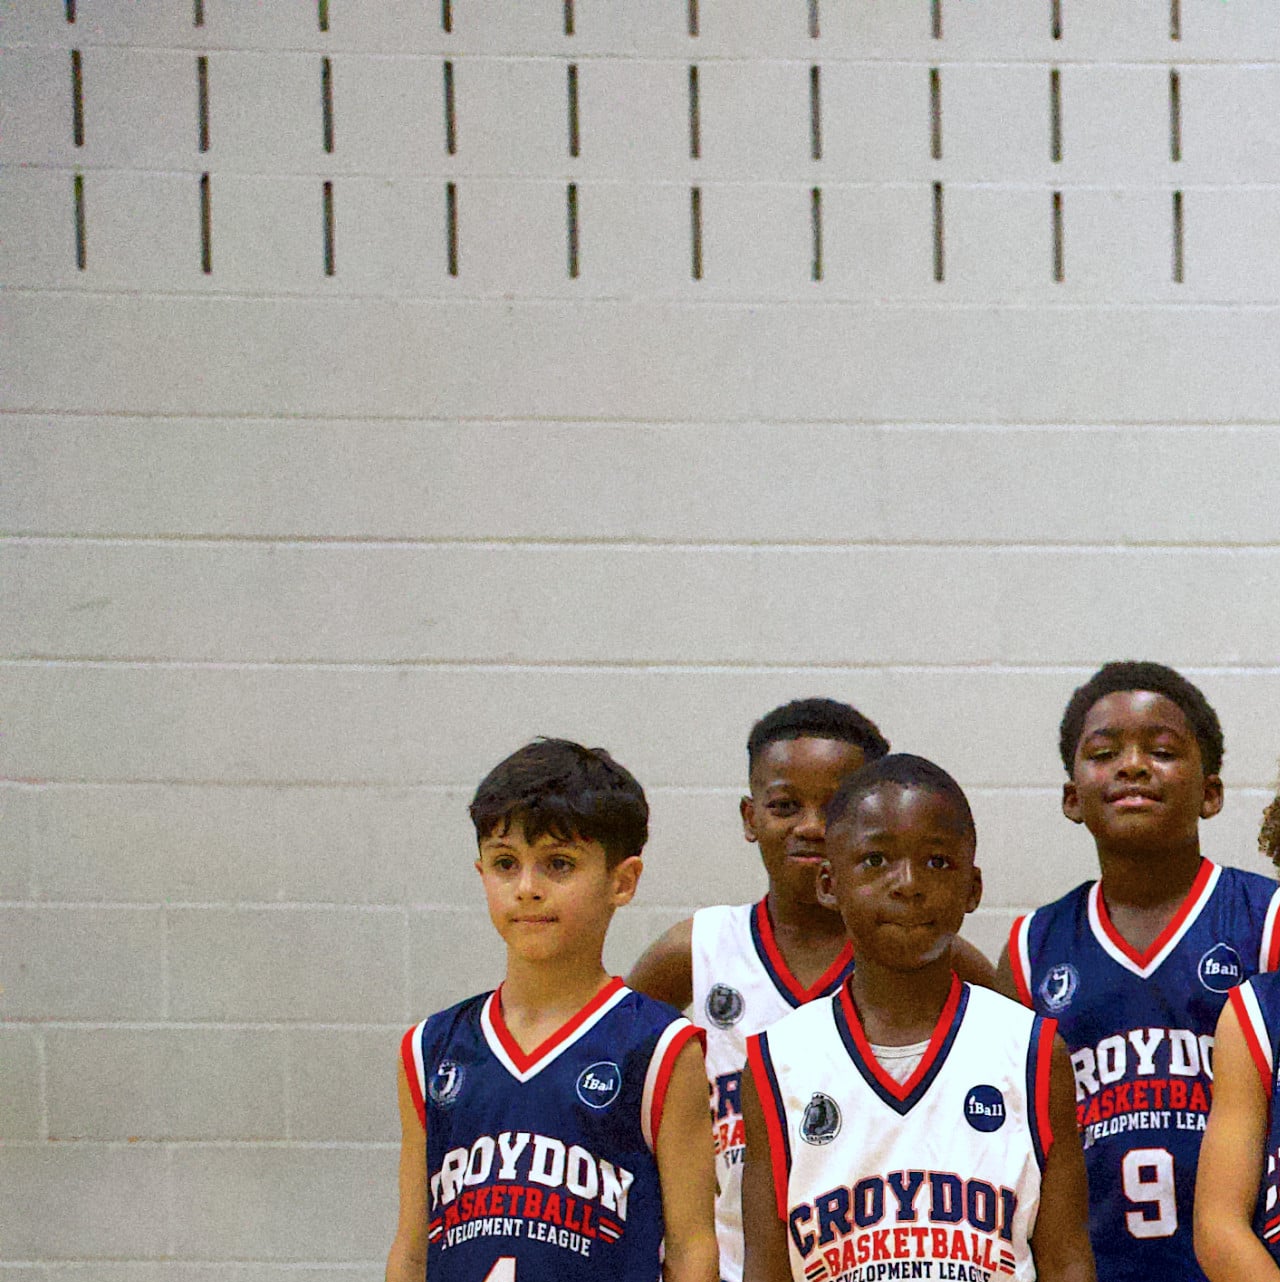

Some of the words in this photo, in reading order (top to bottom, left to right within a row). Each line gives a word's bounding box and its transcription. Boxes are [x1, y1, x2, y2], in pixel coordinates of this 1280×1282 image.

[967, 1094, 1003, 1118] iBall
[430, 1131, 635, 1222] ROYDON
[1121, 1147, 1179, 1240] 9
[528, 1220, 592, 1257] LEAGUE
[824, 1227, 998, 1277] BASKETBALL
